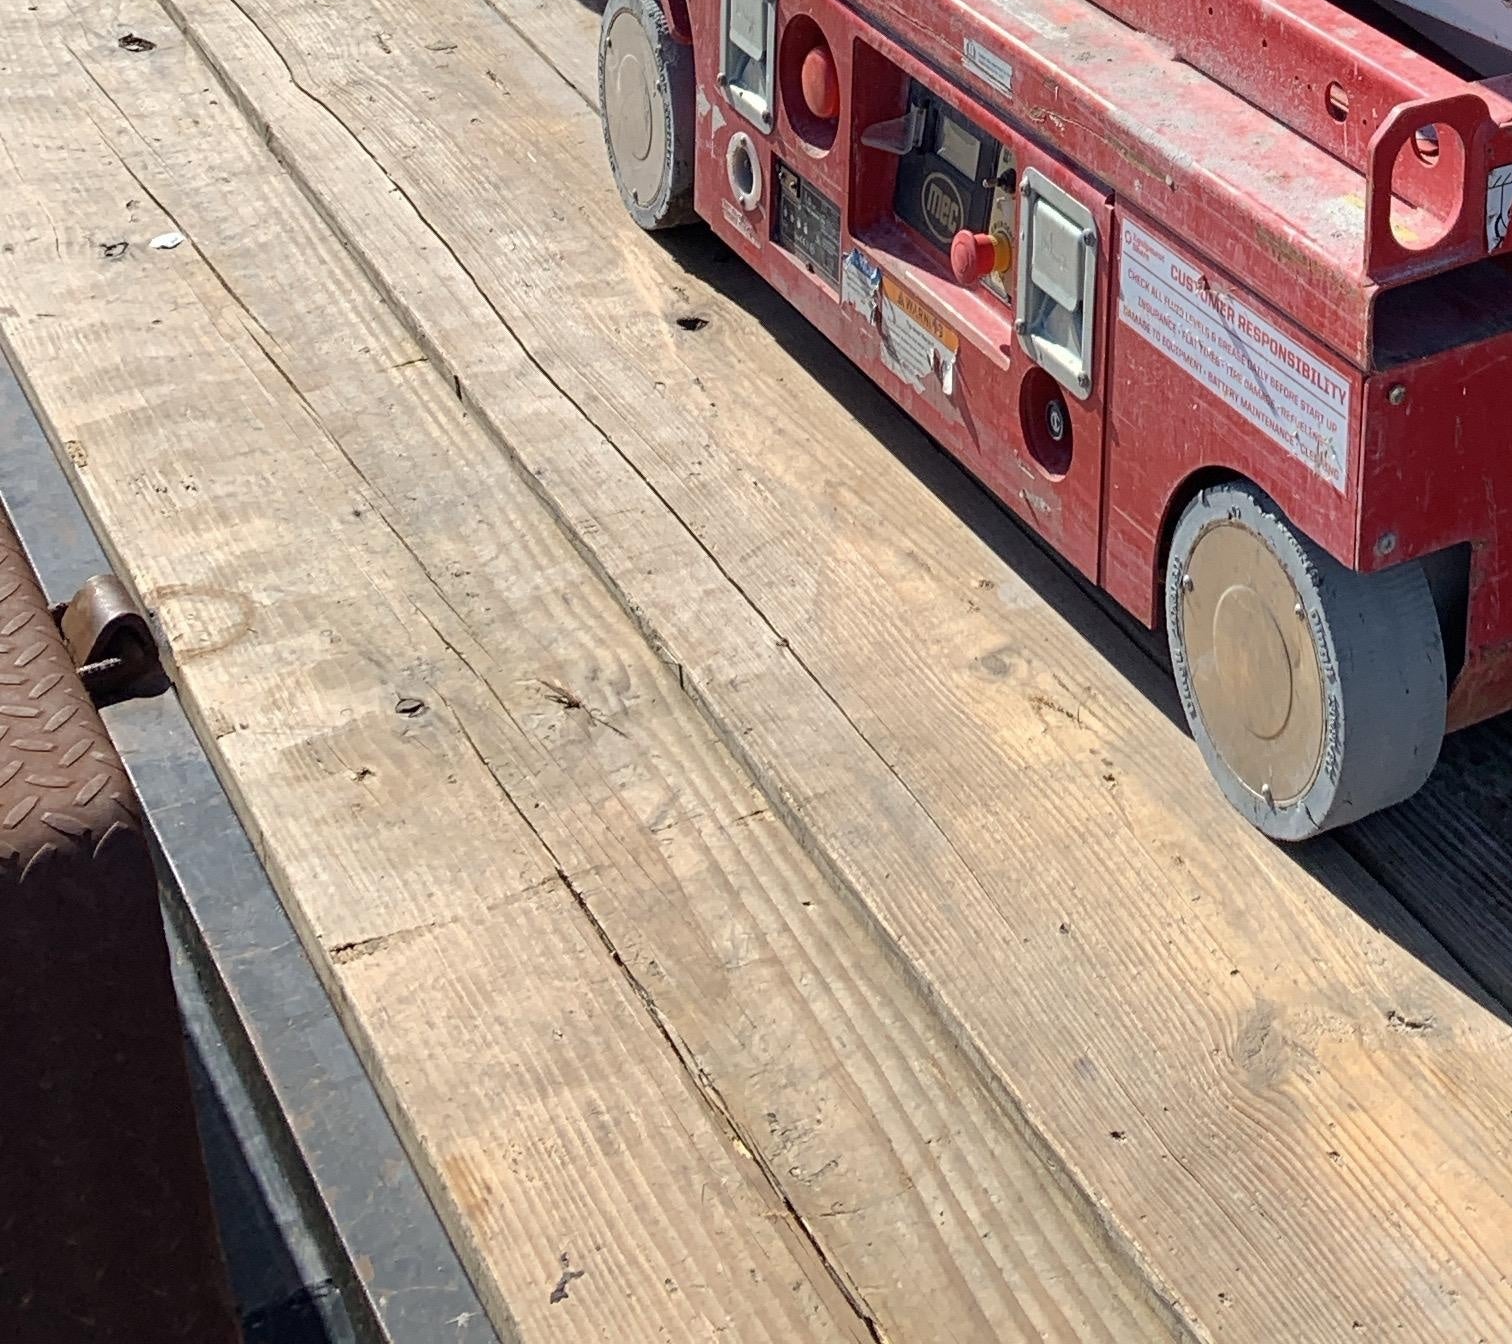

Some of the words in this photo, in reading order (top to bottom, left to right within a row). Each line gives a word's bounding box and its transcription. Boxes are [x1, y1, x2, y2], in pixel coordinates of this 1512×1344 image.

[1122, 304, 1151, 335] DAMAGE
[1151, 327, 1161, 343] TO
[1161, 335, 1203, 375] EQUIPMENT
[1207, 370, 1239, 403] BATTERY
[1239, 395, 1294, 447] MAINTENANCE
[1127, 267, 1150, 293] CHECK
[1150, 285, 1164, 304] ALL
[1163, 295, 1185, 319] FLUID
[1185, 311, 1210, 340] LEVELS
[1217, 335, 1246, 367] GREASE
[1247, 358, 1269, 383] DAILY
[1269, 375, 1300, 406] BEFORE
[1300, 399, 1324, 425] START
[1326, 417, 1338, 433] UP
[1137, 296, 1177, 333] INSURANCE
[1181, 330, 1199, 350] FLAT
[1237, 313, 1347, 406] RESPONSIBILITY
